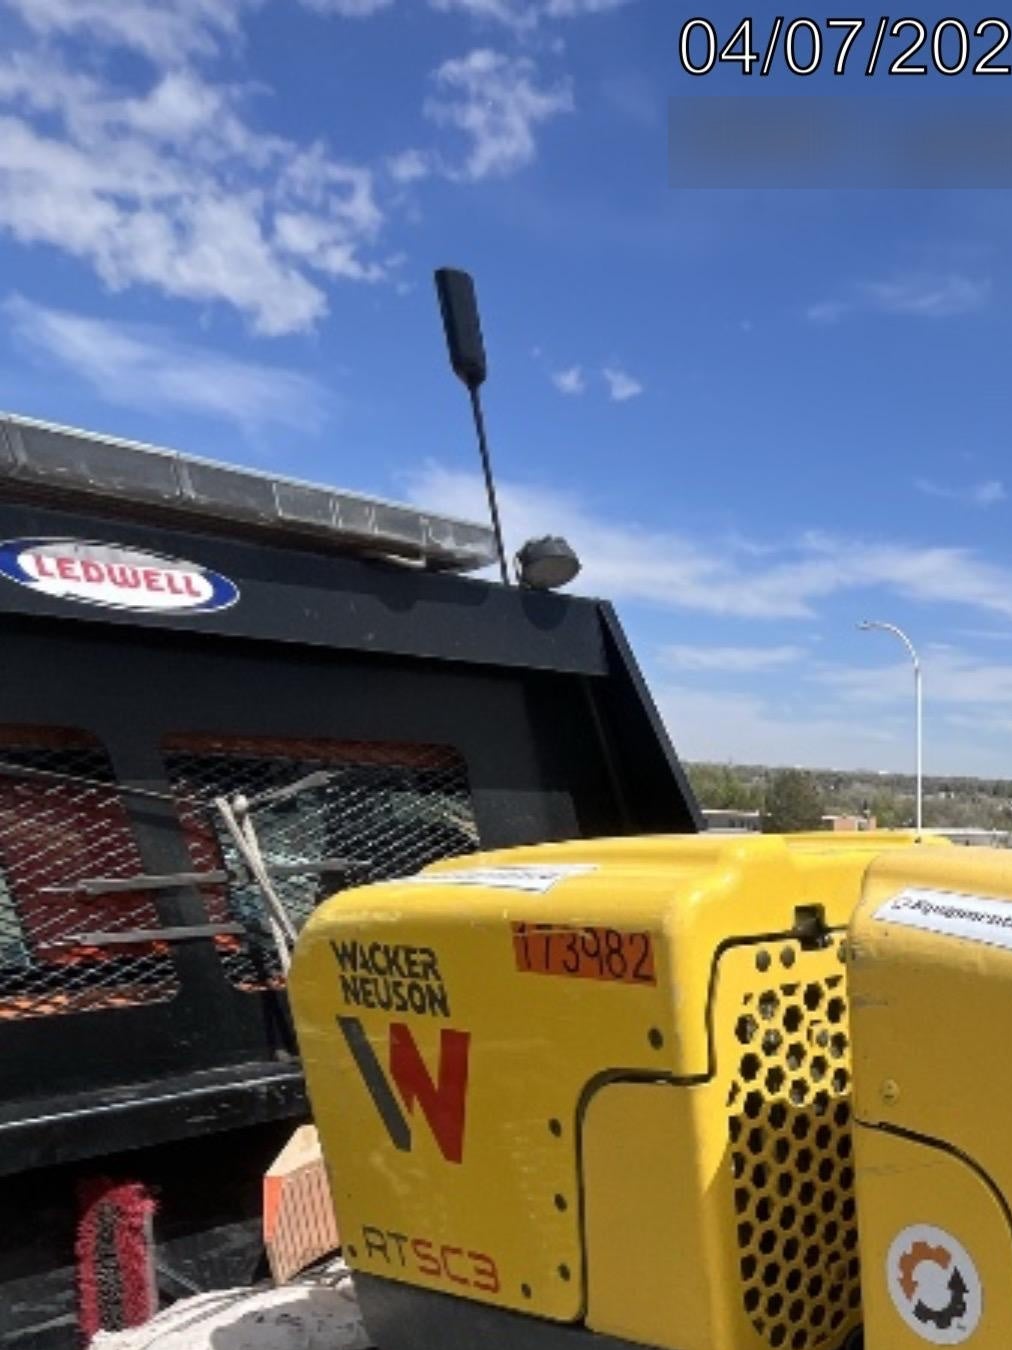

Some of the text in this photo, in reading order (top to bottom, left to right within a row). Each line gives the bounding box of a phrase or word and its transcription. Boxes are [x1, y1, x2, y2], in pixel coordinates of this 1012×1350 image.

[33, 555, 201, 597] LEDWELL
[330, 940, 442, 981] WACKER
[517, 922, 654, 980] 173982
[340, 974, 450, 1017] NEUSON
[362, 1225, 499, 1293] RTSC3
